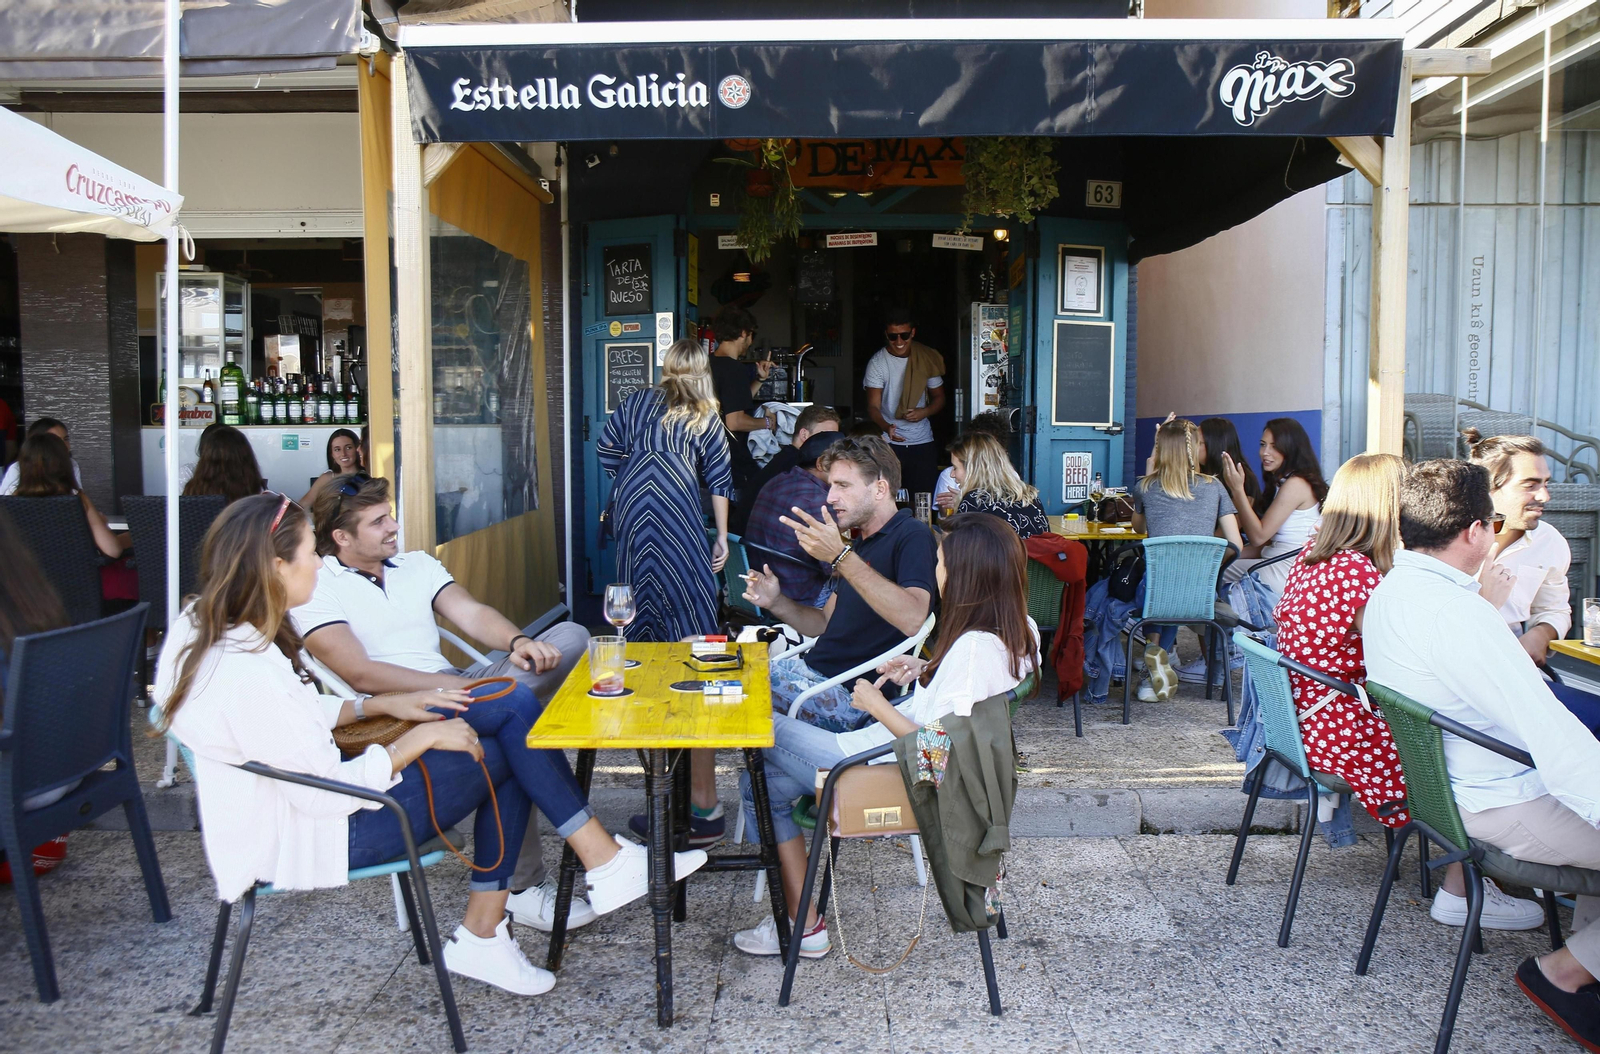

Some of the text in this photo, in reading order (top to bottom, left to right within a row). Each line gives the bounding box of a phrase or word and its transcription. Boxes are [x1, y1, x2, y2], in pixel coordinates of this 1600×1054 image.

[450, 77, 582, 112] Estrella
[588, 73, 710, 109] Galicia
[807, 141, 866, 177] DE
[873, 137, 964, 179] MAX
[1094, 184, 1114, 204] 63
[607, 259, 642, 276] TARTA
[616, 276, 632, 285] DE
[1471, 255, 1485, 298] Uzun
[610, 290, 643, 303] QUESO
[609, 349, 643, 365] CREPS
[1066, 456, 1082, 468] COLD
[1065, 468, 1088, 484] BEER
[1067, 487, 1086, 499] HERE!
